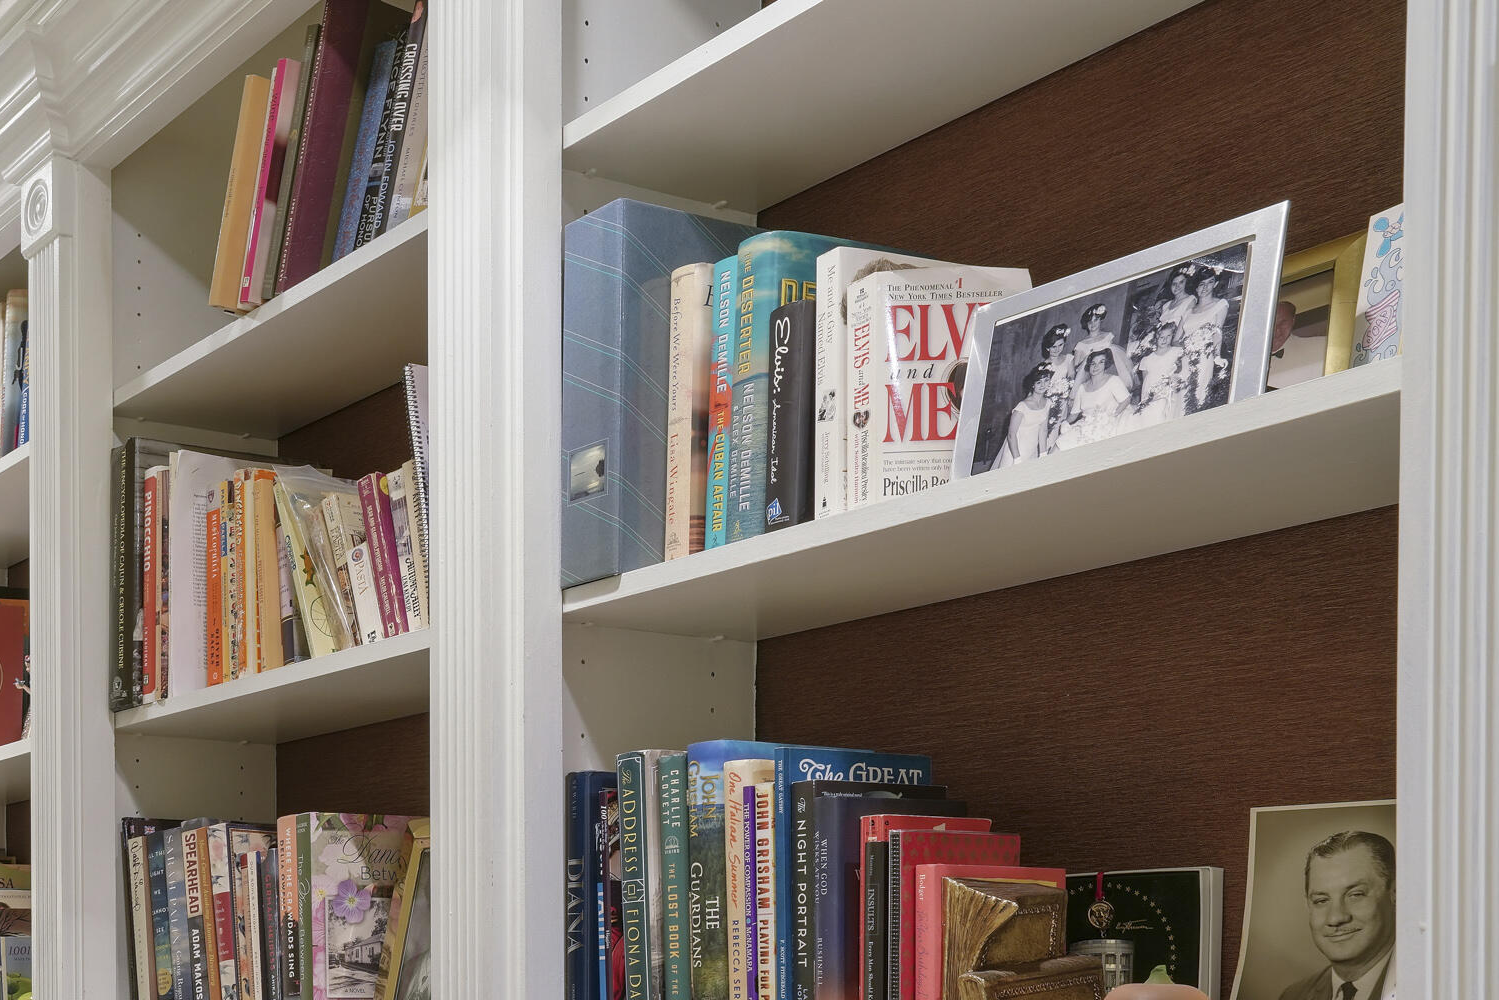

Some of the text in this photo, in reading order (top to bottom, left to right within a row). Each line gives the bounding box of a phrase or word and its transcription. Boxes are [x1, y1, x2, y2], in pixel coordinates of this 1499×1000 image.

[374, 31, 406, 159] VINCE FLYNN
[390, 43, 417, 133] CROSSING OVER
[373, 139, 396, 229] JOHN EDWARD
[719, 270, 731, 328] NELSON
[738, 275, 754, 375] DESERTER
[826, 264, 837, 344] Me and Guy
[817, 311, 827, 386] Named Elvis
[885, 302, 991, 362] ELV
[852, 323, 870, 410] ELVIS and ME
[667, 298, 682, 524] Before We Were Yours Lisa Wingate
[717, 411, 725, 429] THE
[732, 415, 740, 446] ALEX
[741, 383, 755, 445] NELSON
[770, 400, 781, 454] American
[883, 381, 958, 443] ME
[713, 433, 725, 480] CUBAN
[770, 457, 779, 484] Idol
[712, 485, 724, 532] AFFAIR
[883, 474, 928, 496] Priscilla
[143, 491, 152, 571] PINOCCHIO
[330, 525, 345, 562] PASTA
[354, 561, 368, 596] PASTA
[621, 767, 632, 785] The
[729, 771, 742, 795] One
[799, 758, 843, 781] The
[600, 805, 608, 819] 100
[661, 774, 670, 826] LOVETT
[670, 769, 681, 828] CHARLIE
[688, 760, 700, 838] GRISHAM
[701, 774, 719, 819] JOHN
[756, 792, 769, 829] JOHN
[285, 828, 293, 864] WHERE
[622, 789, 638, 873] ADDRESS
[728, 799, 742, 848] Italian
[166, 834, 181, 945] SARAH PALIN
[668, 863, 676, 884] THE
[730, 853, 743, 909] Summer
[744, 864, 752, 916] COMPASSION
[757, 838, 771, 909] GRISHAM
[797, 799, 808, 967] The NIGHT PORTRAIT
[820, 839, 828, 895] WHEN GOD
[918, 873, 926, 901] Bodger
[185, 833, 203, 1000] SPEARHEAD ADAM MAKOS
[265, 874, 273, 921] GERMAN
[286, 891, 295, 950] CRAWDADS
[567, 856, 585, 958] DIANA
[667, 885, 679, 918] LOST
[689, 862, 703, 968] GUARDIANS
[705, 896, 720, 930] THE
[867, 888, 875, 931] INSULTS
[626, 909, 640, 978] FIONA
[669, 925, 680, 960] BOOK
[731, 919, 740, 974] REBECCA
[745, 926, 753, 972] McNAMARA
[759, 919, 770, 965] PLAYING
[816, 937, 824, 988] BUSHNELL
[760, 970, 770, 990] FOR
